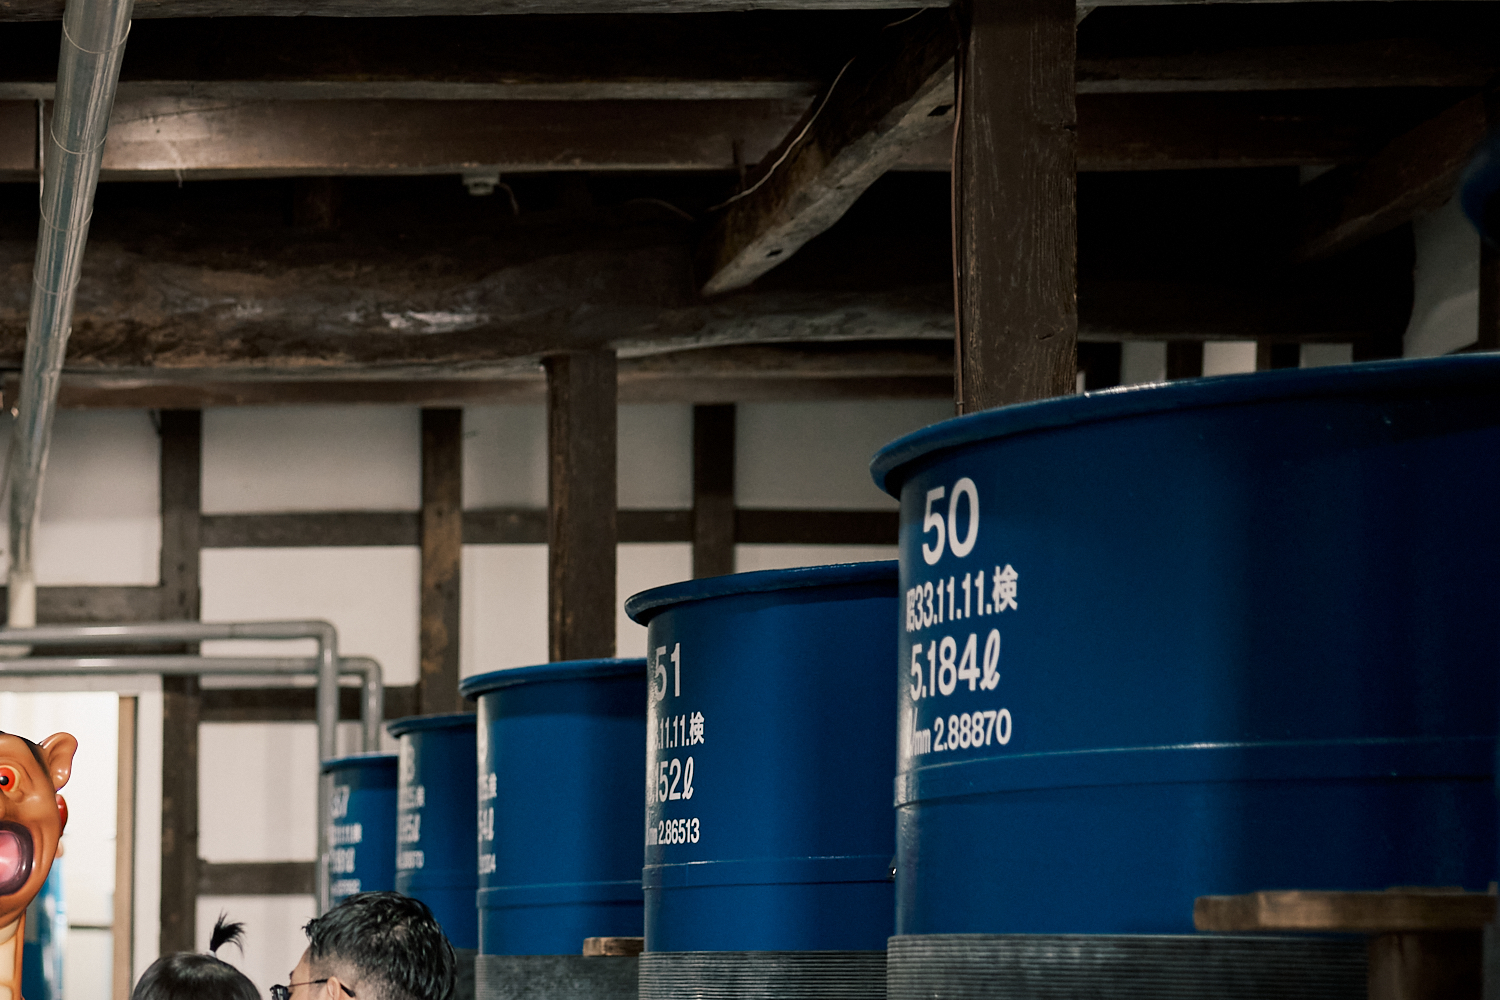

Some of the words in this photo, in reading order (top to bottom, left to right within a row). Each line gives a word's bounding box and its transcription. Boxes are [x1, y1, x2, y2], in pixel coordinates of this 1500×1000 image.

[922, 477, 979, 565] 50
[654, 643, 680, 701] 51
[933, 708, 1012, 751] 2.88870
[658, 817, 700, 845] 2.86513
